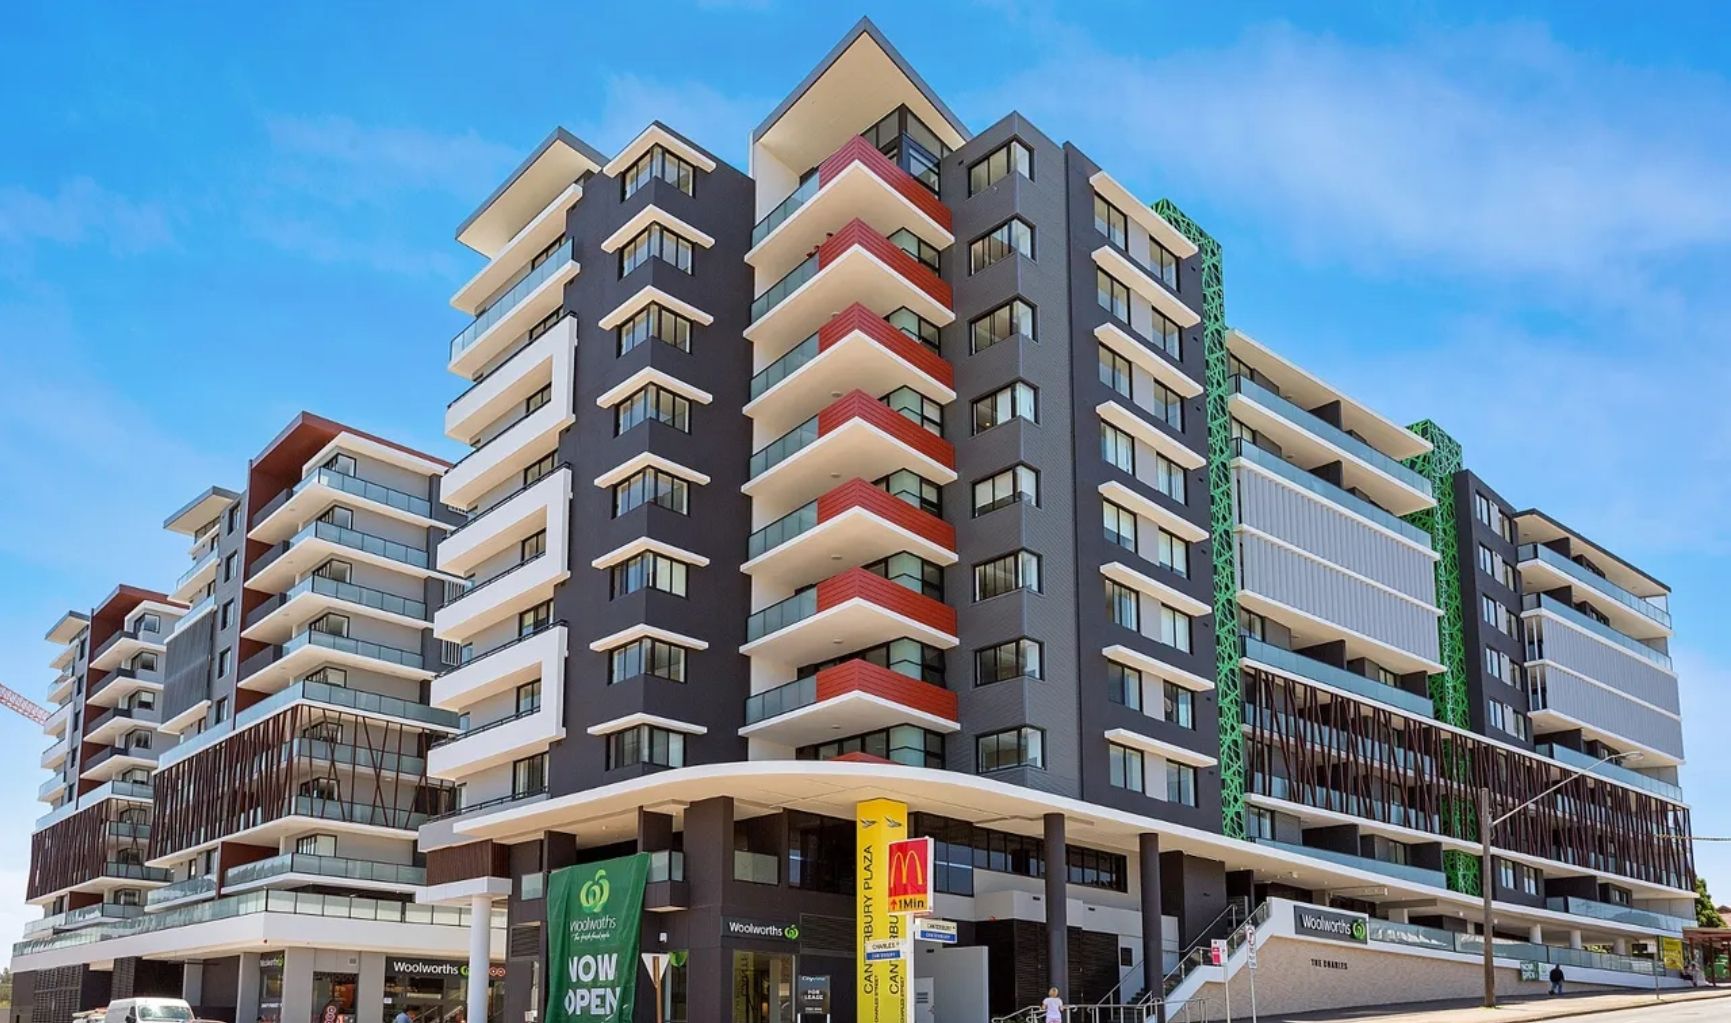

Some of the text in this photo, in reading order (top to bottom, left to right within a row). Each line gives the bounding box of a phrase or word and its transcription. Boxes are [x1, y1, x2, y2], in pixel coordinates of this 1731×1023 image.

[729, 921, 782, 936] Woolworths
[863, 845, 874, 994] CANRBURY PLAZA
[1301, 913, 1351, 935] Woolworths
[393, 961, 459, 975] Woolworths
